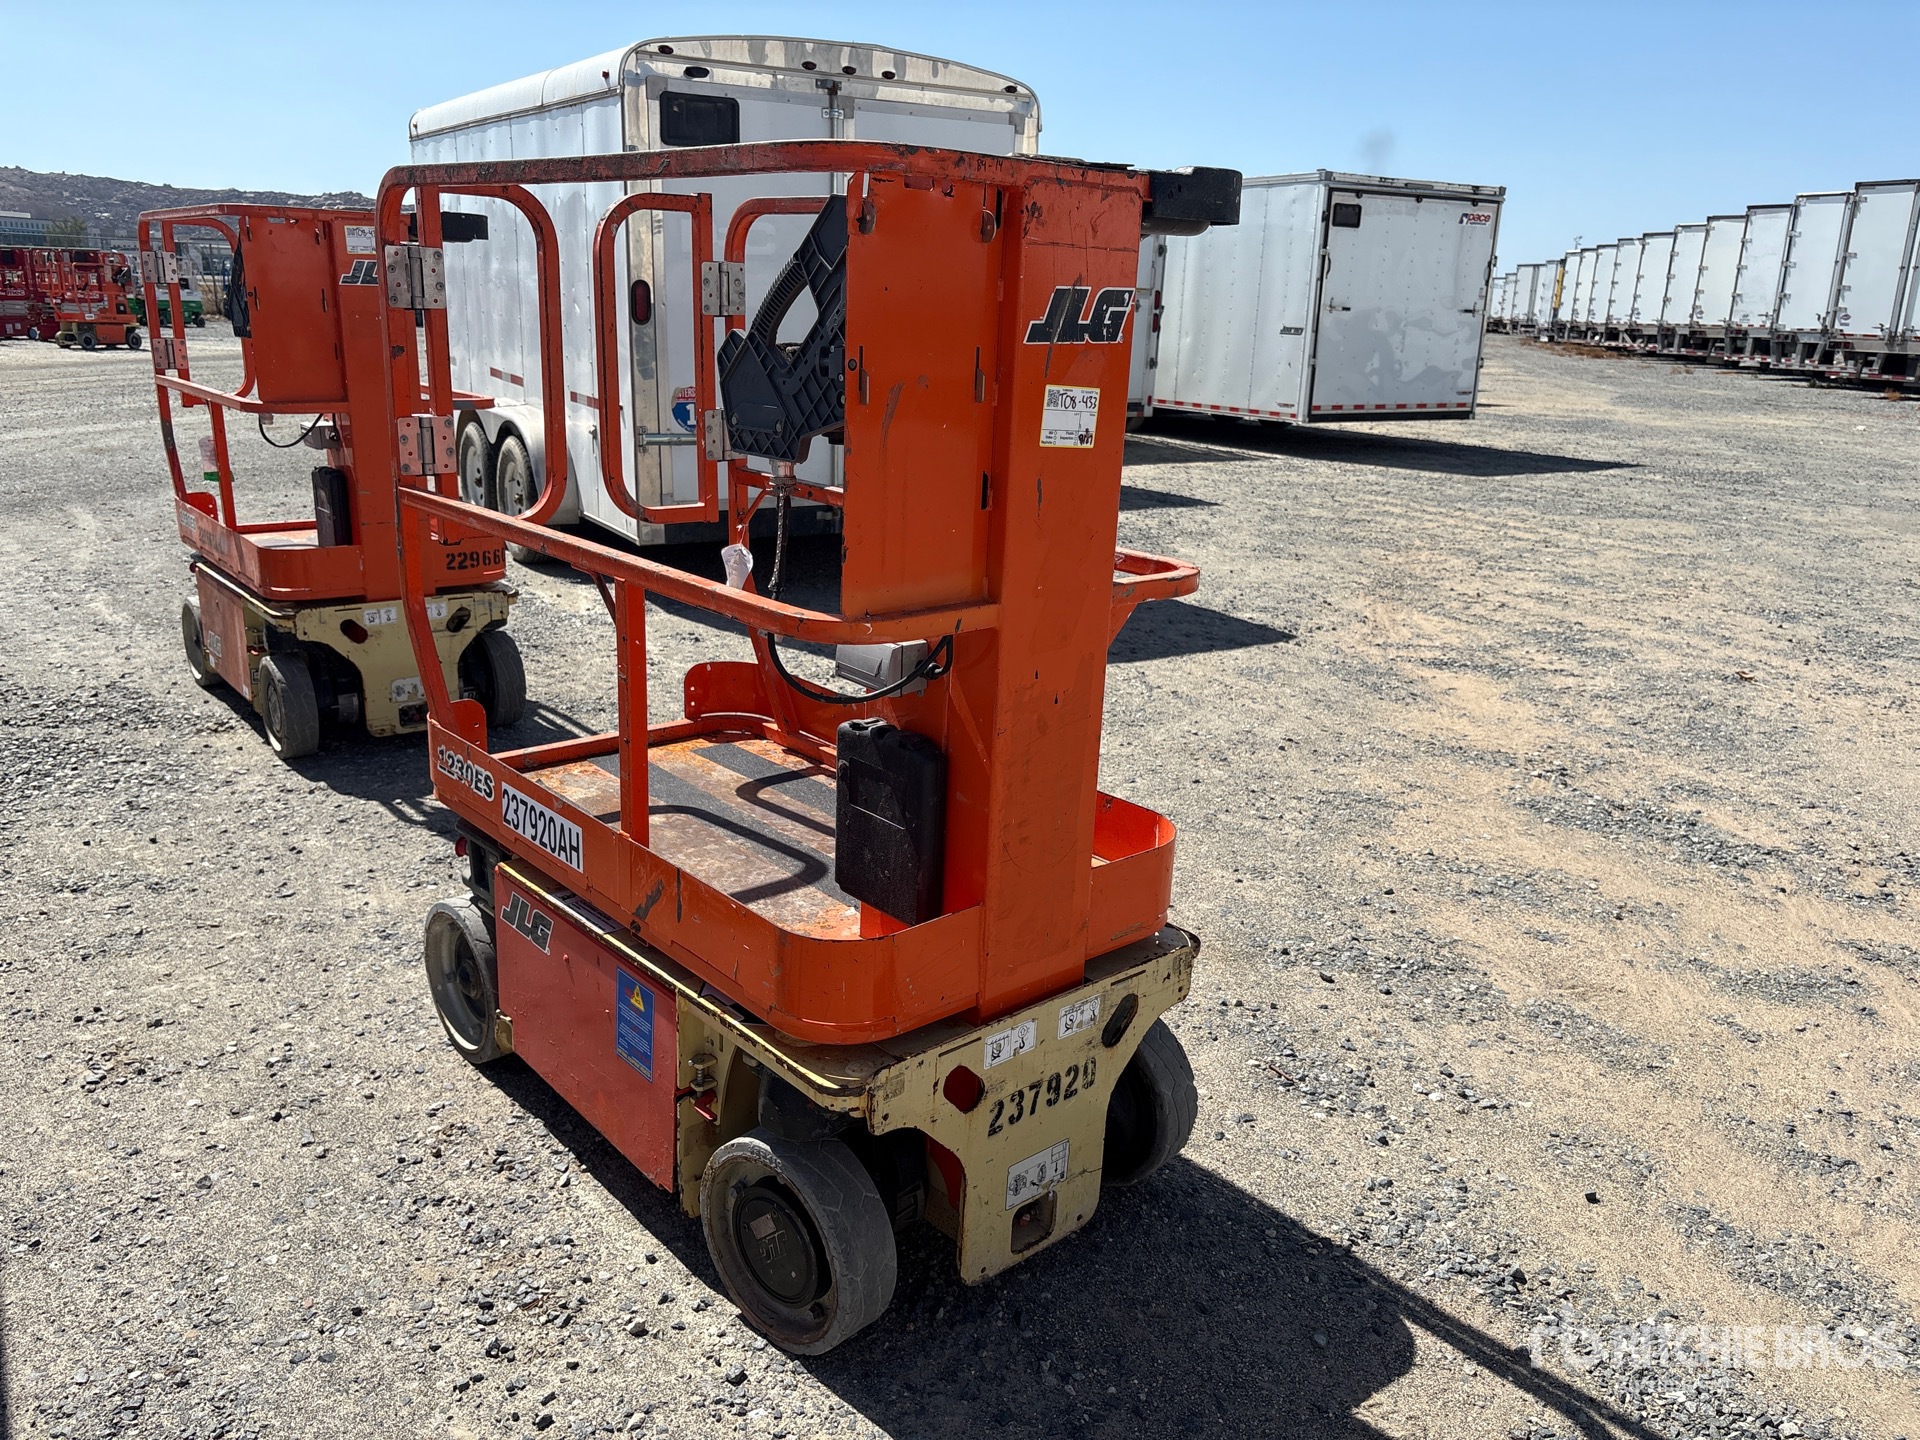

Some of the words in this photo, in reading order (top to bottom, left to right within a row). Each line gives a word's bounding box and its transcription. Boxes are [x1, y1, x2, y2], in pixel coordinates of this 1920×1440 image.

[339, 259, 379, 287] JL
[1023, 286, 1136, 344] JLG
[437, 744, 495, 802] 1230ES
[502, 787, 581, 871] 237920AH
[500, 891, 554, 956] JLG
[988, 1056, 1097, 1137] 237920
